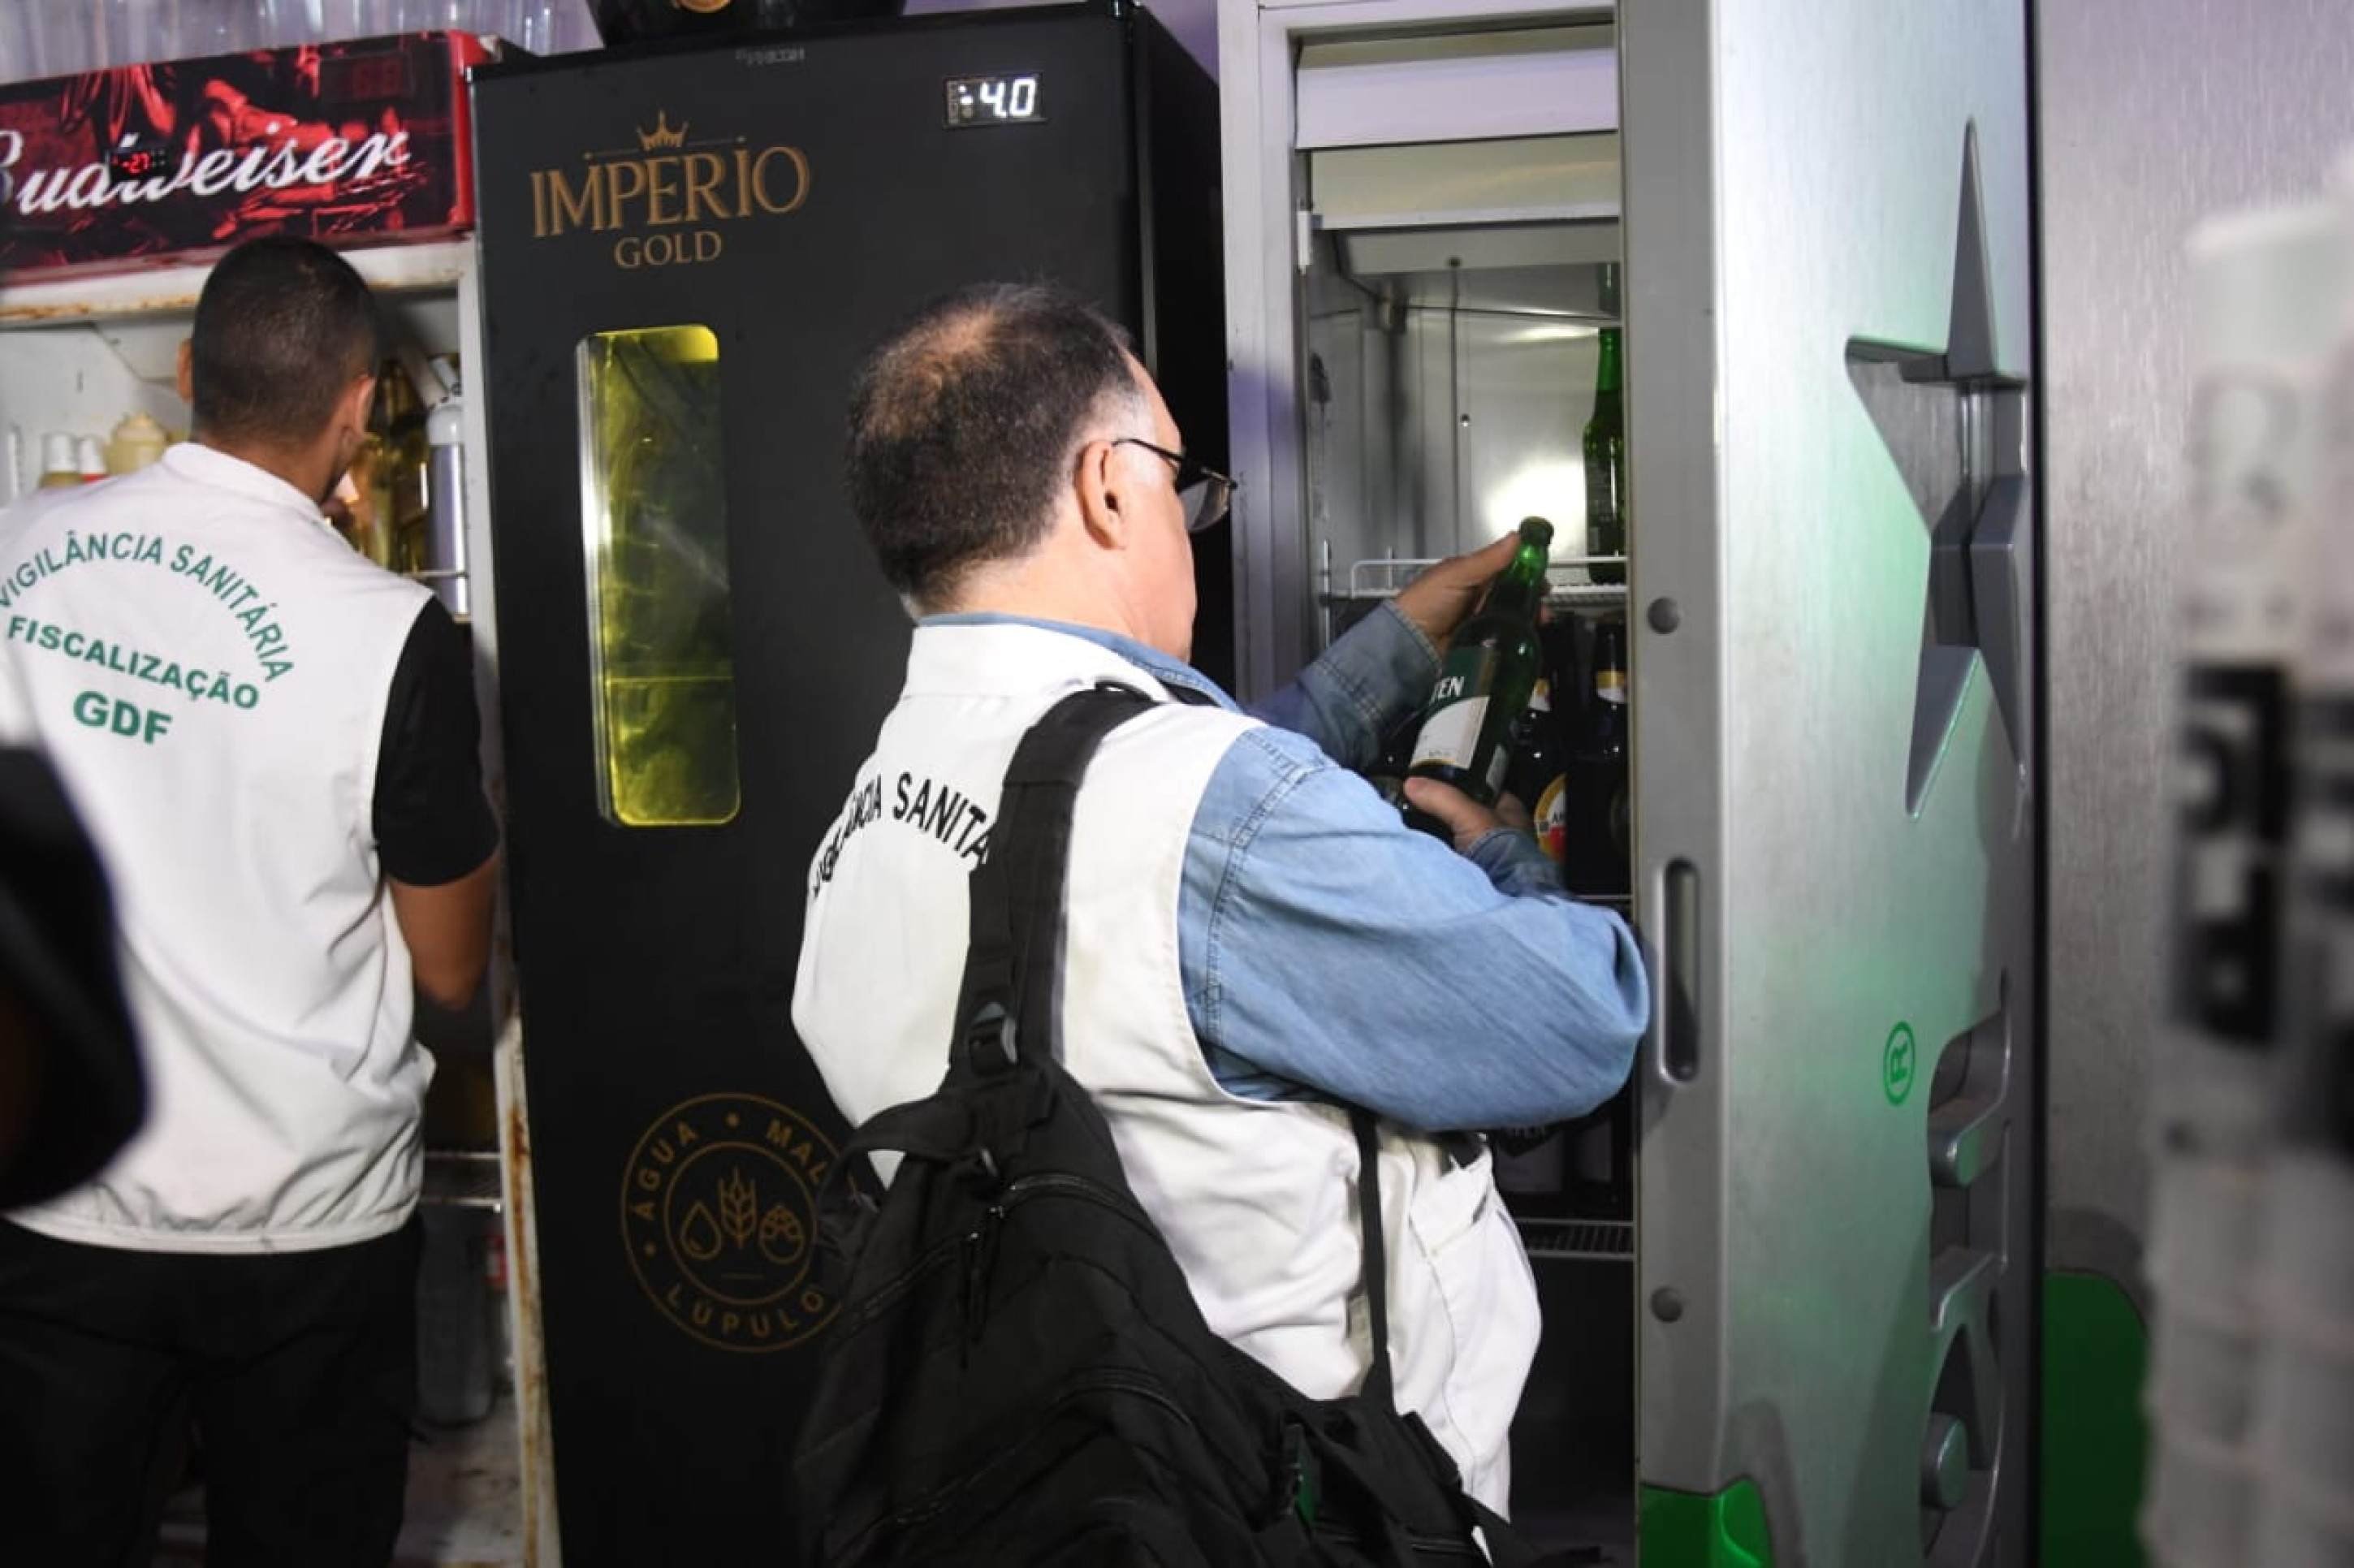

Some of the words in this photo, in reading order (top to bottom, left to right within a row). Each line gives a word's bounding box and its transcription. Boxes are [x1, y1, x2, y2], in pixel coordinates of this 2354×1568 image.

[614, 231, 723, 269] GOLD
[170, 544, 295, 683] SANITÁRIA
[6, 616, 260, 711] FISCALIZAÇÃO
[72, 690, 173, 745] GDF
